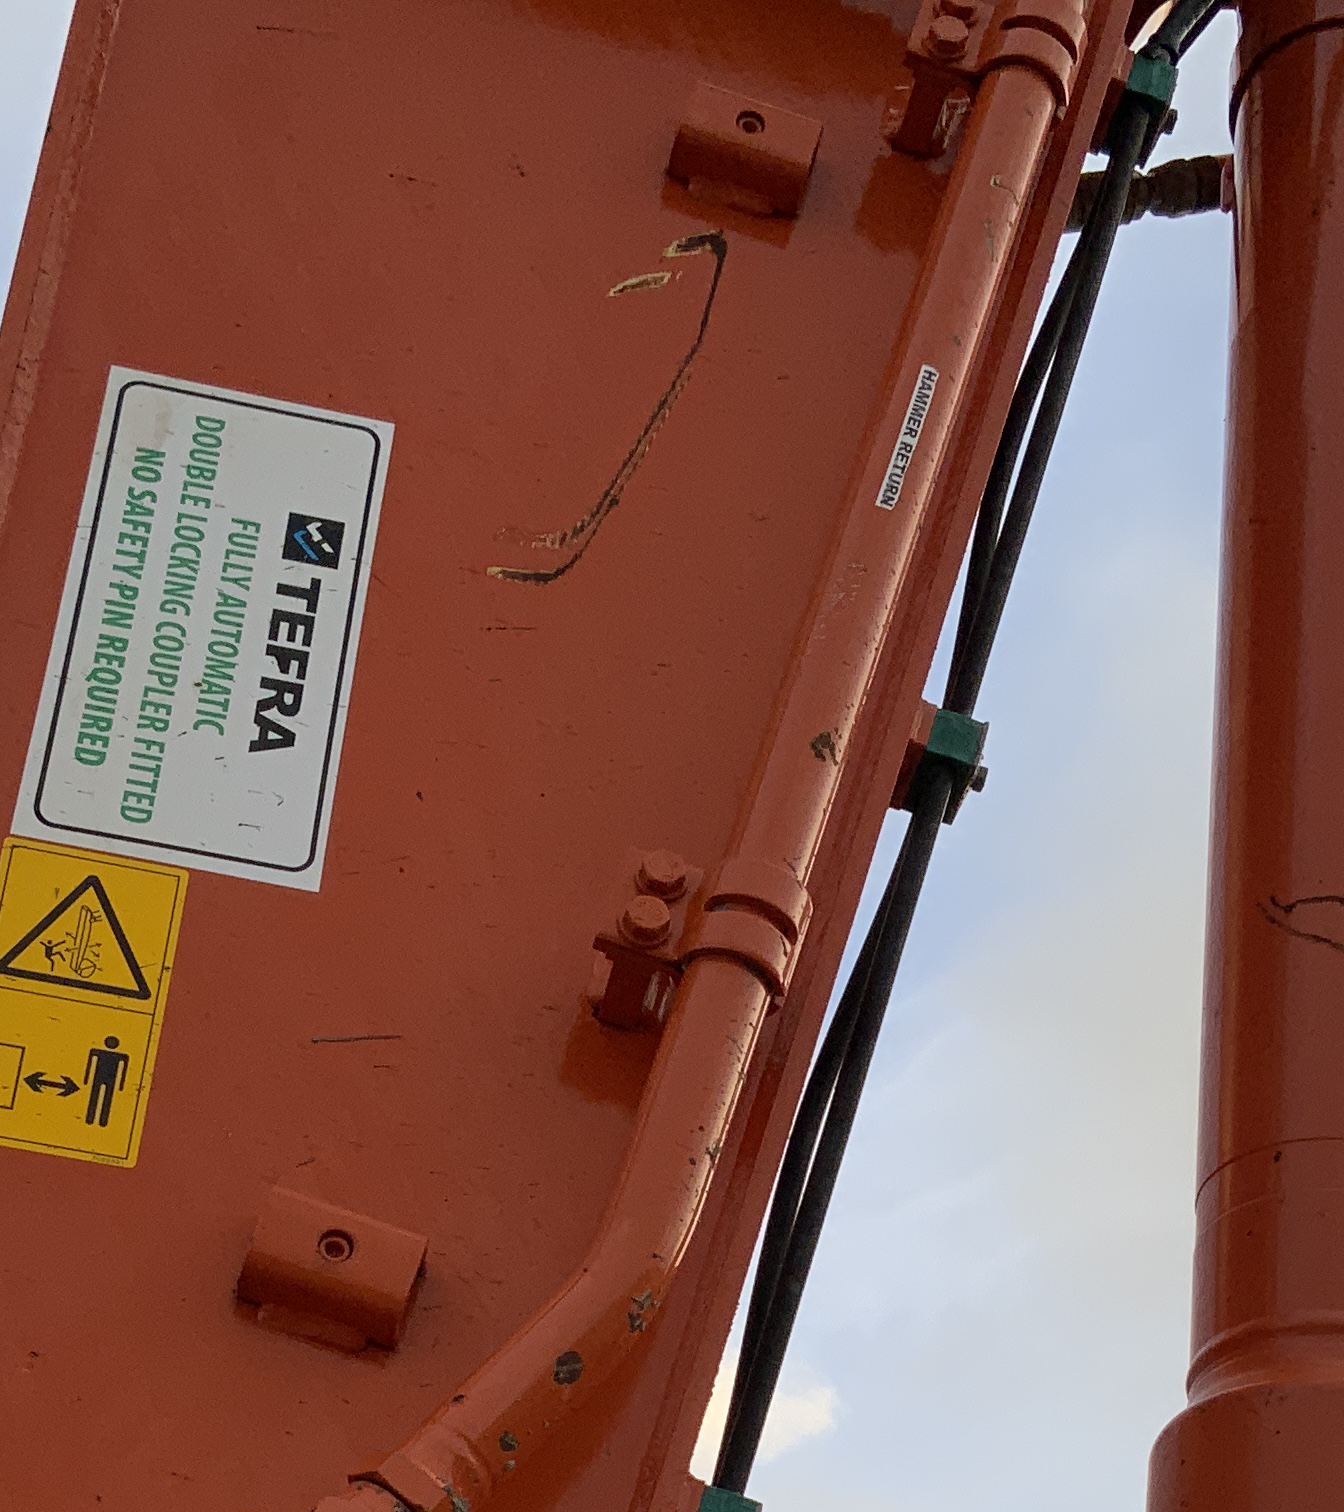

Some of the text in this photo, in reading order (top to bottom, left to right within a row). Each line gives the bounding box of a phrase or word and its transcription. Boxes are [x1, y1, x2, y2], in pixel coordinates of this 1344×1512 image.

[880, 369, 938, 508] HAMMER RETURN
[73, 446, 167, 767] NO SAFETY PIN REQUIRED
[120, 414, 226, 824] DOUBLE LOCKING COUPLER FITTED
[193, 516, 262, 737] FULLY AUTOMATIC
[247, 576, 322, 753] TEFRA
